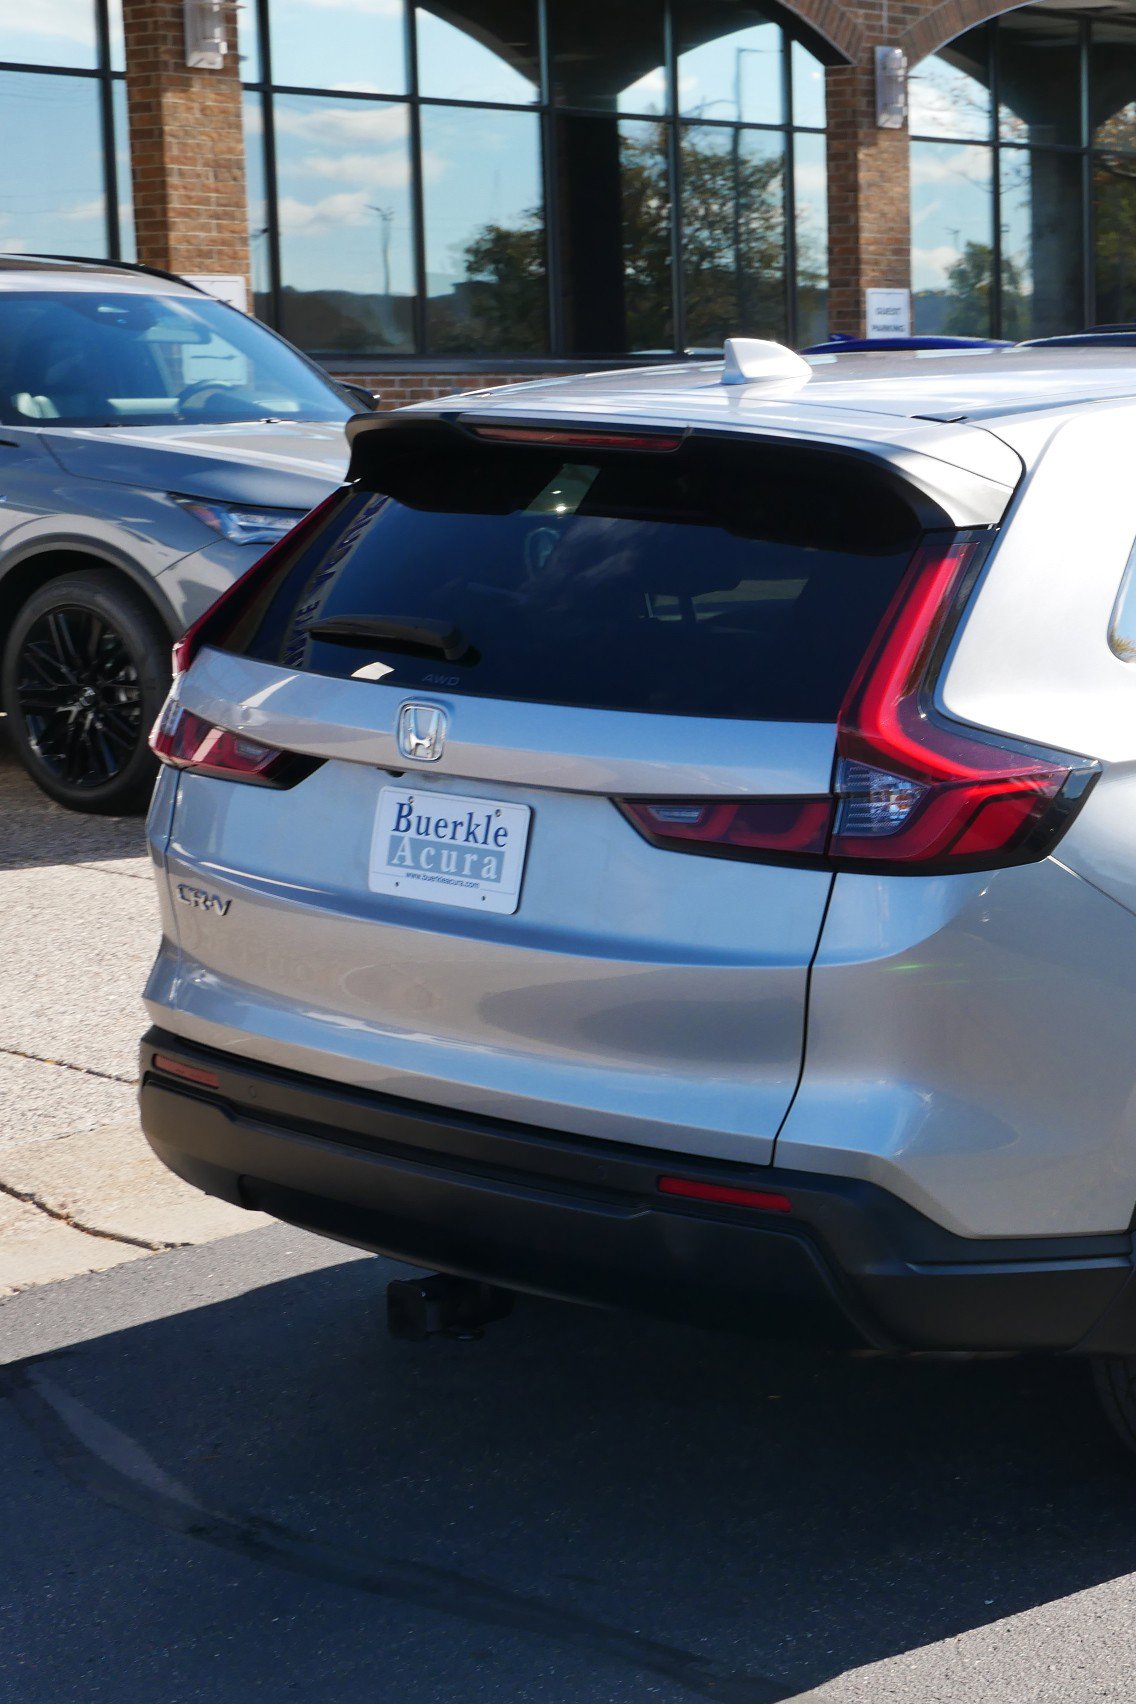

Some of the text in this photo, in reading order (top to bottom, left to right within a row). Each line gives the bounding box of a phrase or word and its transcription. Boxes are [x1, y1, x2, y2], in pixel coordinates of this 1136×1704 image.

[421, 672, 461, 687] AWD
[392, 801, 509, 848] Buerkle
[391, 836, 499, 880] Acura
